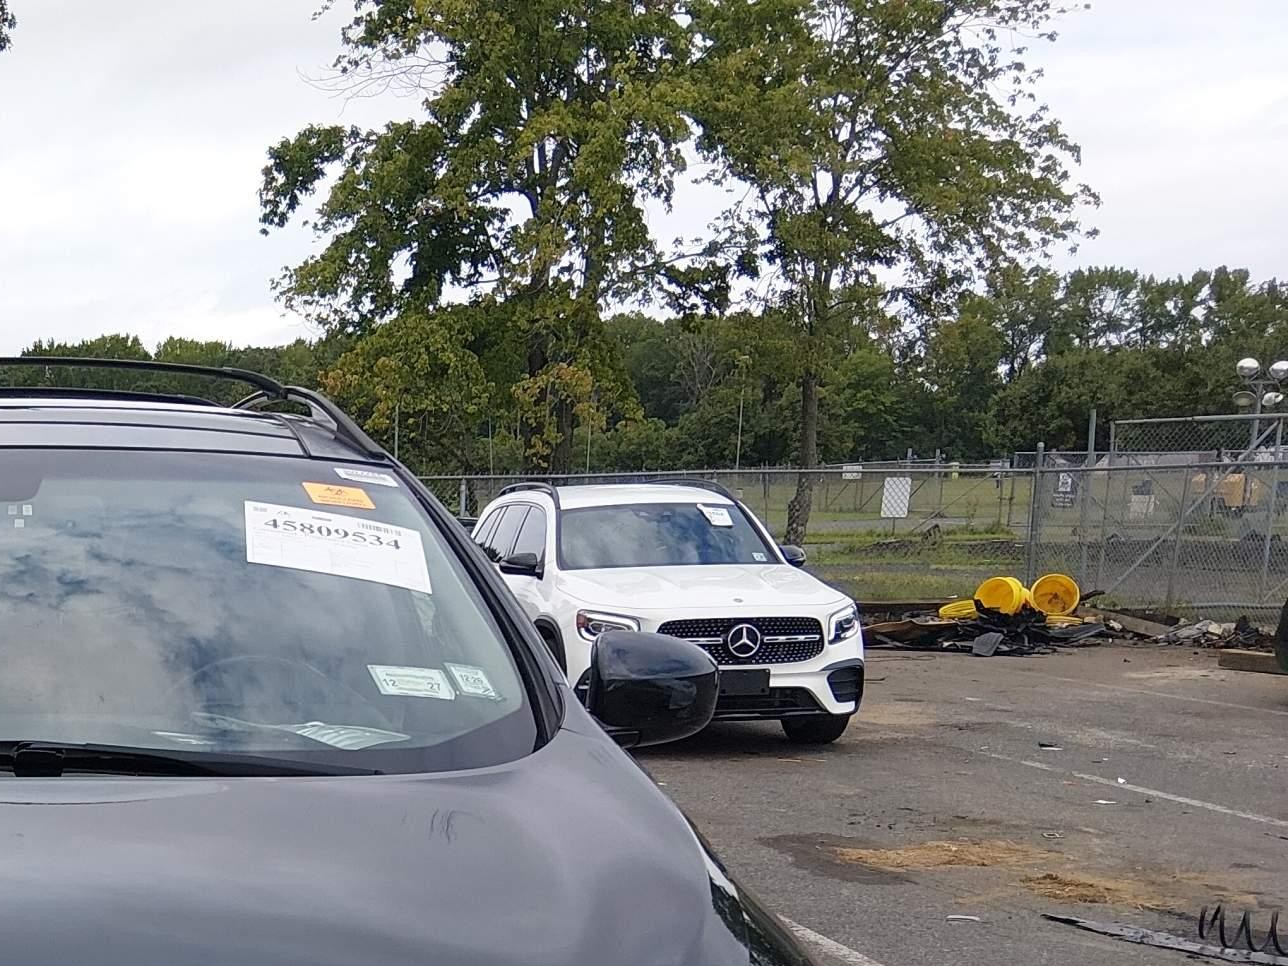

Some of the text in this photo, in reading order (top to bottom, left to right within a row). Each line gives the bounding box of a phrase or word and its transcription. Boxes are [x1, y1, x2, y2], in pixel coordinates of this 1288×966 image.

[263, 517, 402, 551] 45809534
[382, 678, 399, 687] 12
[426, 681, 441, 692] 27
